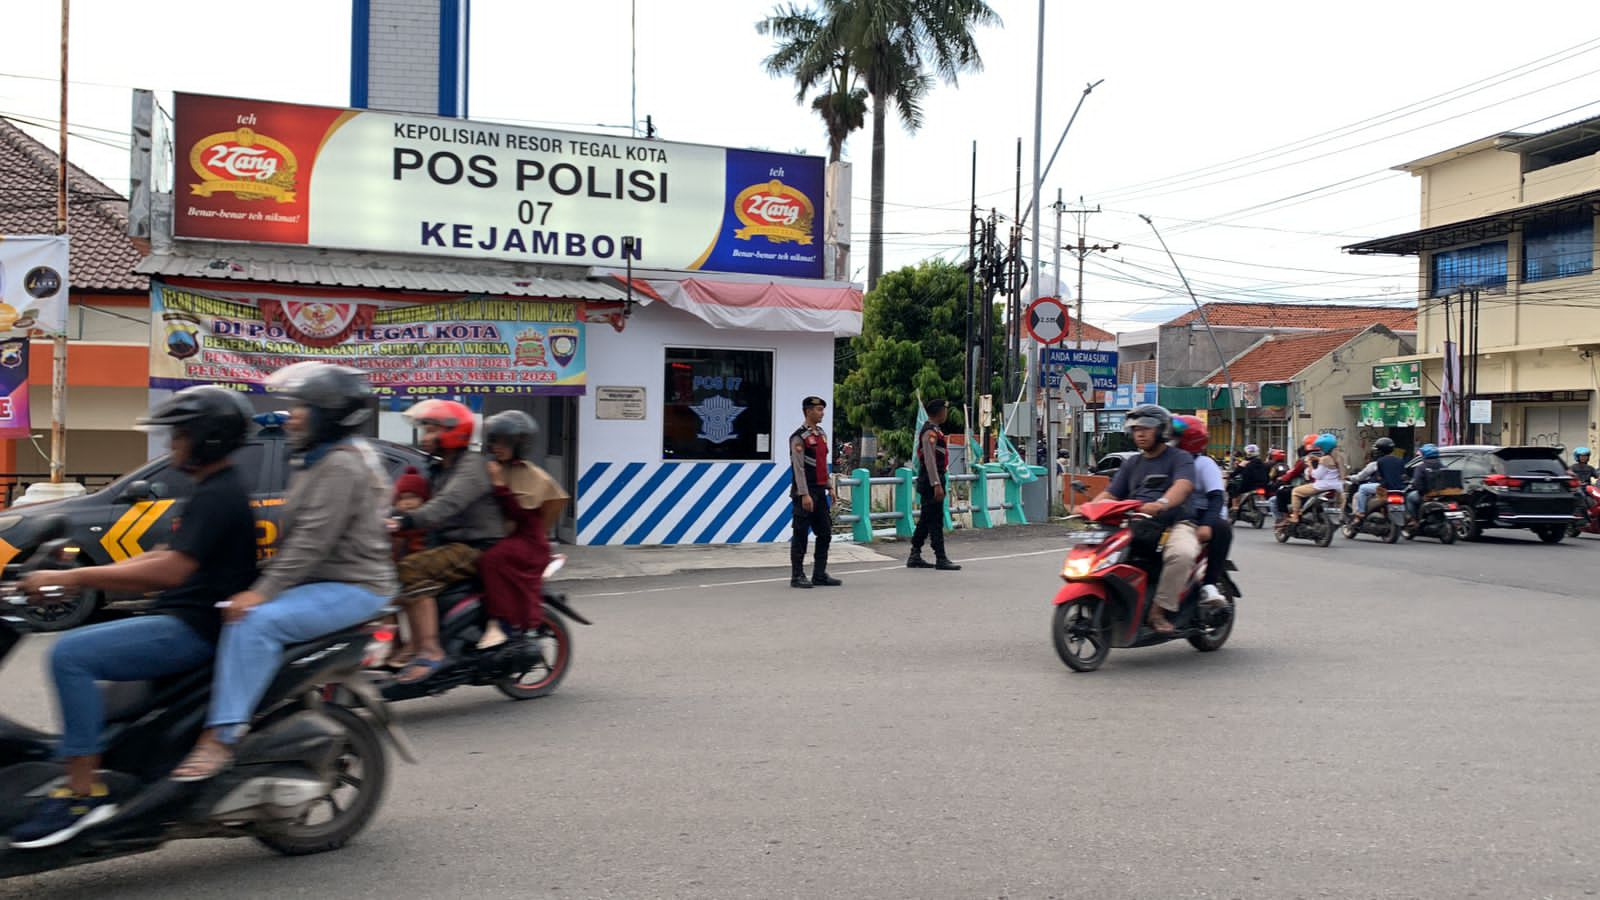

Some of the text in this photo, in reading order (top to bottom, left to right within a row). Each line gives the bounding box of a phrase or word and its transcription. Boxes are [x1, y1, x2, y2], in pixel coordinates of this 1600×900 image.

[236, 112, 257, 125] teh
[394, 123, 668, 164] KEPOLISIAN RESOR TEGAL KOTA
[393, 147, 668, 203] POS POLISI
[769, 167, 785, 177] teh
[187, 206, 247, 219] Benar-benar
[248, 210, 263, 221] teh
[518, 200, 553, 225] 07
[420, 221, 643, 260] KEJAMBON
[732, 249, 777, 260] Benar-benar
[777, 252, 789, 260] teh
[483, 300, 518, 321] JATENG
[519, 302, 550, 321] TAHUN
[551, 303, 575, 321] 2023
[214, 321, 240, 335] DI
[435, 325, 498, 339] KOTA
[204, 336, 262, 352] BEKERJA
[265, 341, 301, 354] SAMA
[359, 344, 377, 355] PT.
[379, 343, 419, 355] SURYA
[423, 343, 461, 354] ARTHA
[463, 343, 510, 354] WIGUNA
[427, 357, 478, 368] JANUARI
[481, 357, 510, 368] 2023
[1050, 352, 1110, 363] ANDA MEMASUKI
[413, 371, 464, 381] BULAN
[467, 371, 517, 381] MARET
[521, 371, 556, 381] 2023
[693, 376, 723, 391] POS
